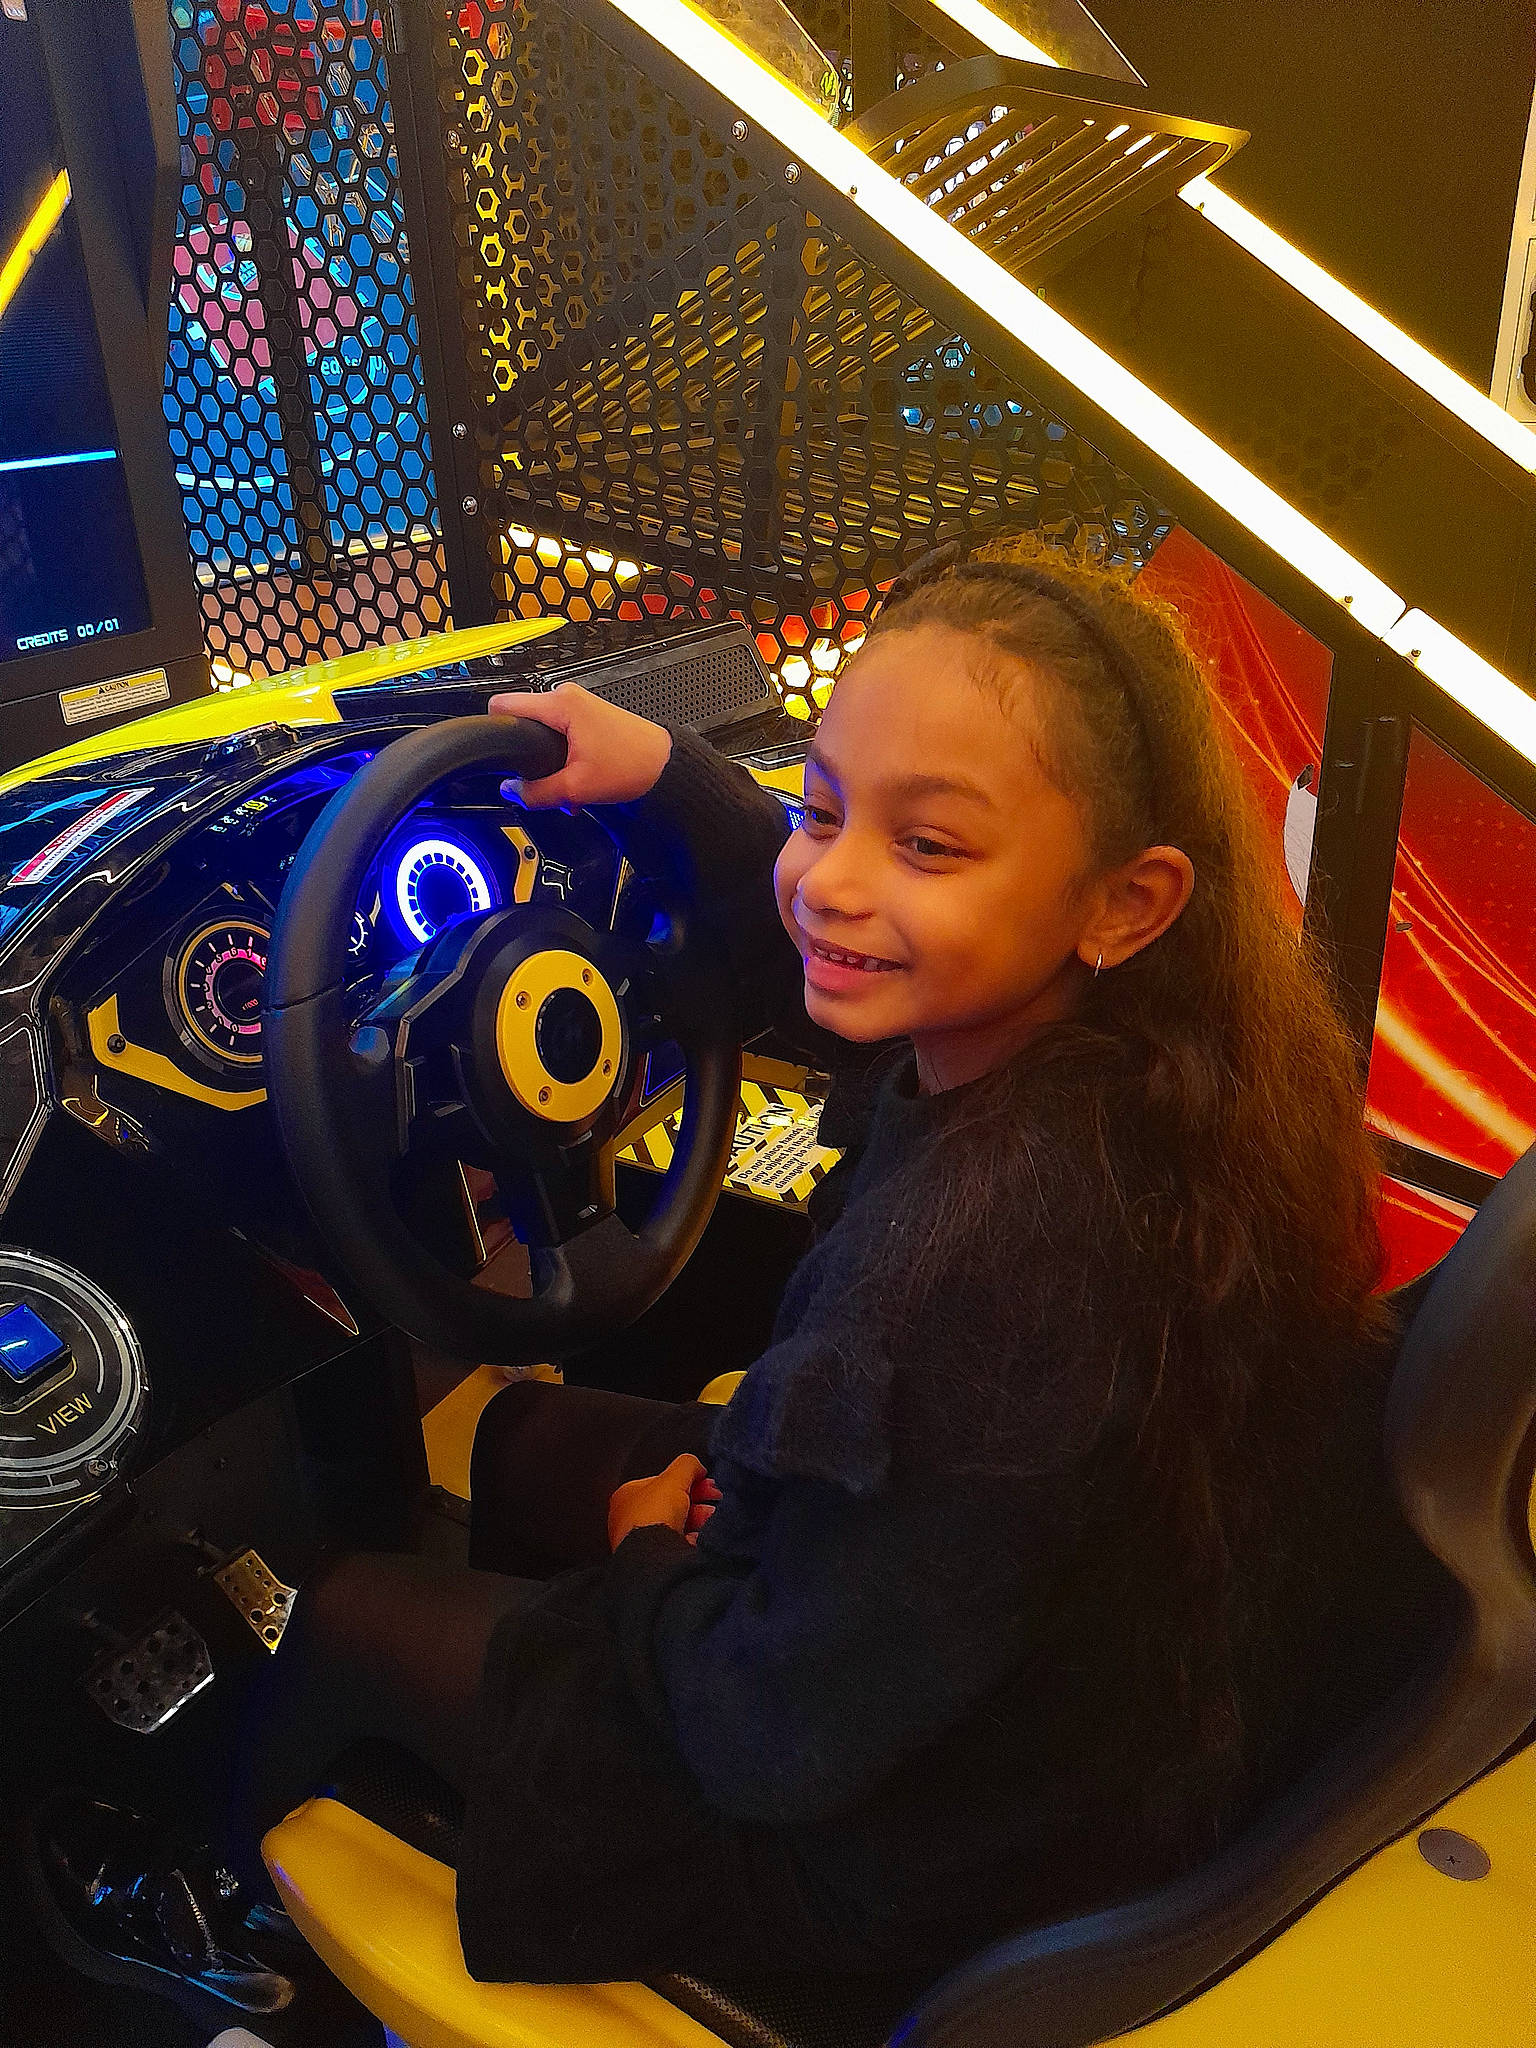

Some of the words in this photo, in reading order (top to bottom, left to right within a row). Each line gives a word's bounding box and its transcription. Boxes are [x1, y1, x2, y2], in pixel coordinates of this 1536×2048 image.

[16, 629, 69, 651] CREDITS
[76, 617, 119, 638] 00/01
[738, 1169, 753, 1179] Do
[751, 1159, 766, 1170] not
[763, 1144, 784, 1161] place
[752, 1170, 769, 1182] any
[765, 1152, 790, 1171] object
[780, 1157, 801, 1171] may
[37, 1392, 93, 1434] VIEW
